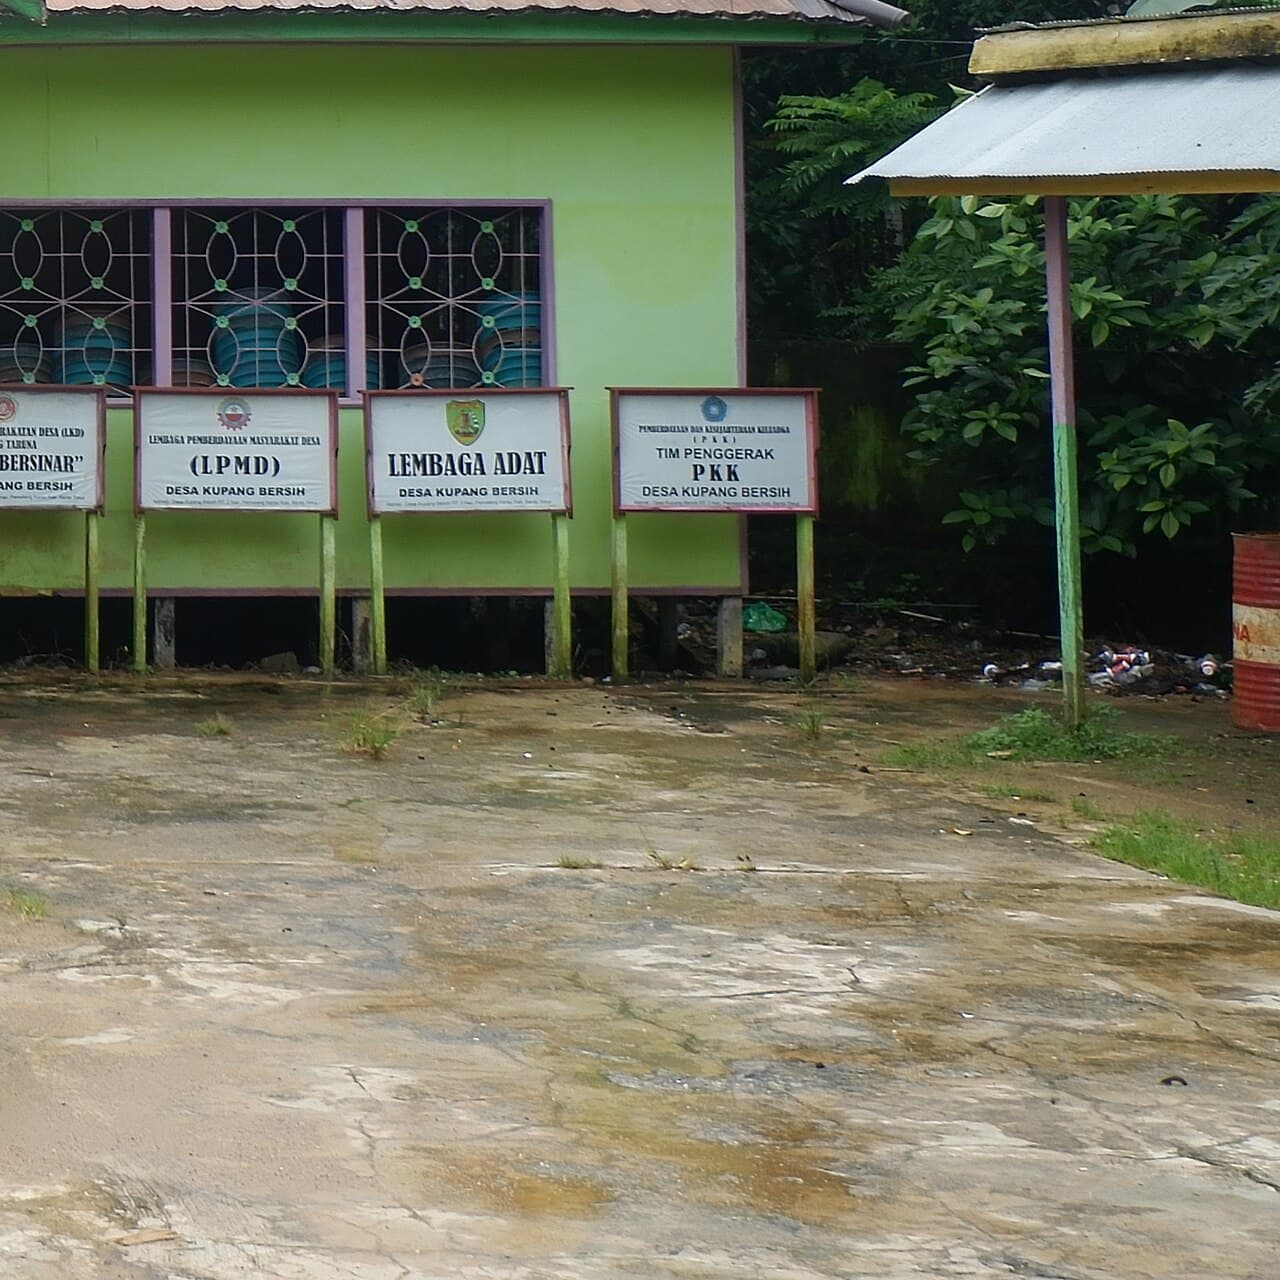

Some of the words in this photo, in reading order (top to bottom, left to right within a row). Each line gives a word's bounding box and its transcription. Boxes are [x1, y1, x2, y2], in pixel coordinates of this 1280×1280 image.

[38, 427, 60, 437] DESA
[149, 435, 185, 445] LEMBAGA
[301, 436, 321, 446] DESA
[656, 447, 680, 459] TIM
[684, 447, 775, 460] PENGGERAK
[190, 455, 281, 477] (LPMD)
[387, 452, 487, 477] LEMBAGA
[494, 451, 547, 475] ADAT
[692, 463, 740, 482] PKK
[27, 481, 73, 491] BERSIH
[166, 486, 199, 496] DESA
[202, 486, 255, 496] KUPANG
[259, 487, 306, 496] BERSIH
[399, 488, 433, 498] DESA
[436, 487, 488, 497] KUPANG
[492, 486, 539, 496] BERSIH
[642, 486, 679, 497] DESA
[682, 486, 738, 497] KUPANG
[741, 487, 791, 498] BERSIH
